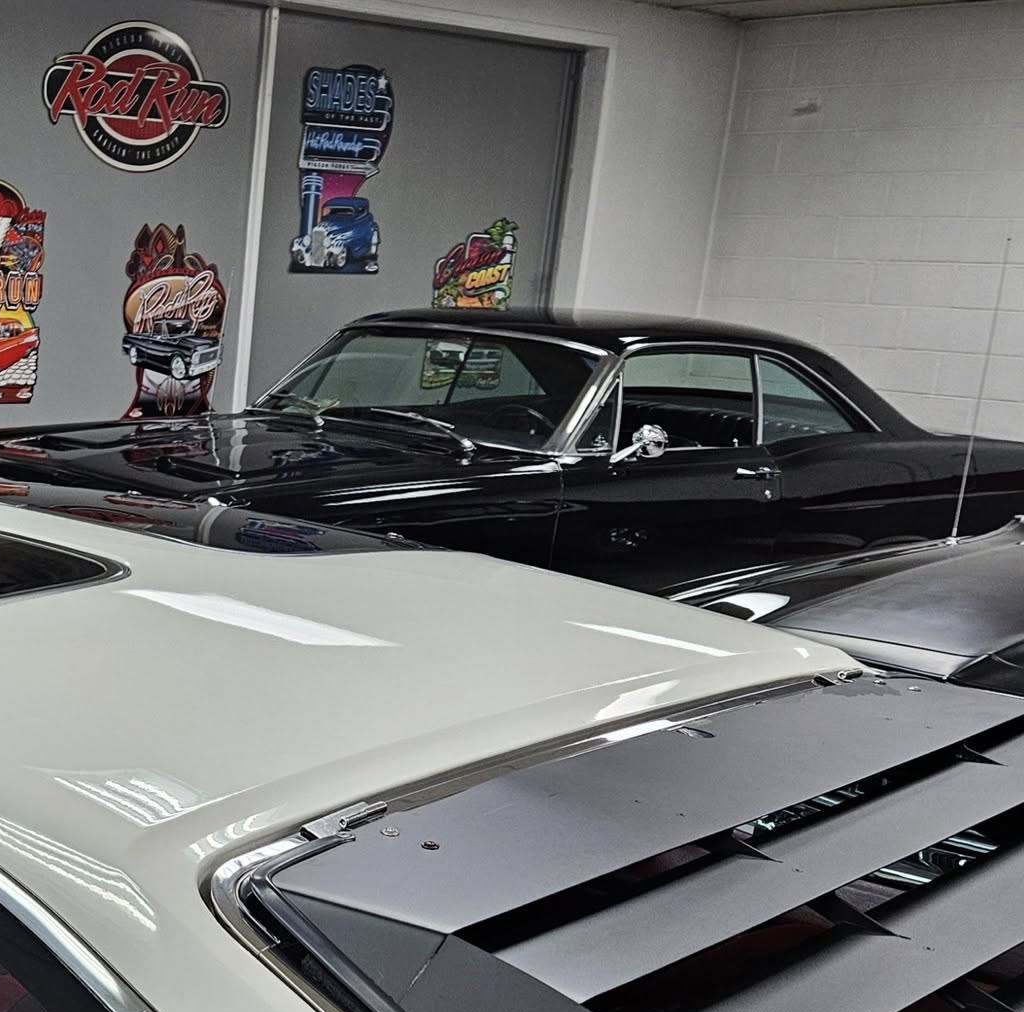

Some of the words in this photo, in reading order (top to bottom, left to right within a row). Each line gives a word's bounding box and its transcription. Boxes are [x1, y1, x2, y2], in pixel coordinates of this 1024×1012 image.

[50, 54, 145, 129] Rod
[137, 62, 224, 135] Run
[306, 71, 378, 113] SHADES
